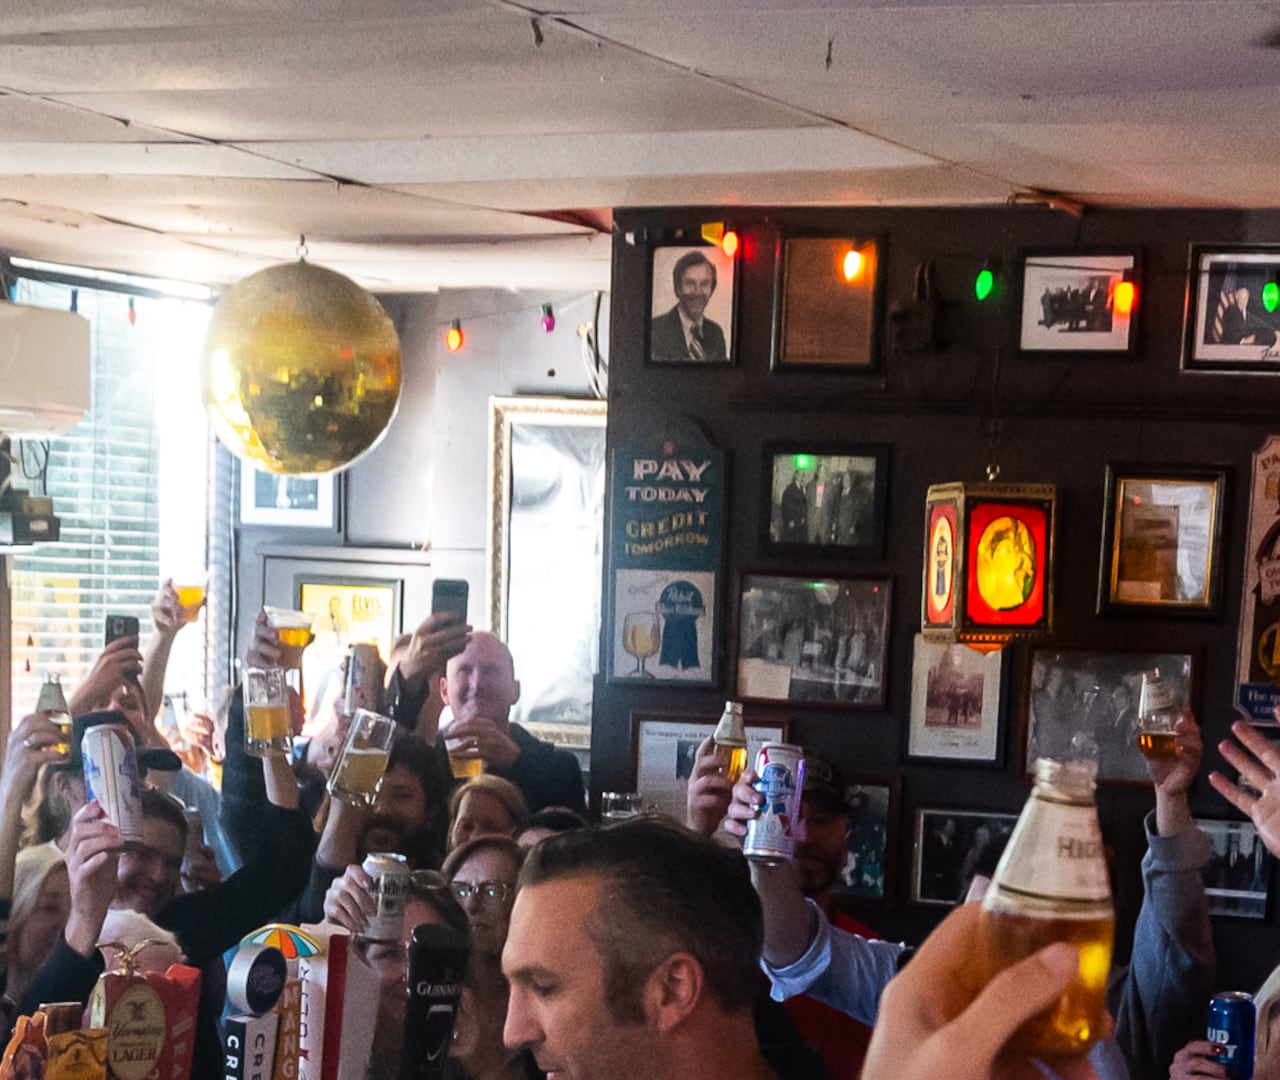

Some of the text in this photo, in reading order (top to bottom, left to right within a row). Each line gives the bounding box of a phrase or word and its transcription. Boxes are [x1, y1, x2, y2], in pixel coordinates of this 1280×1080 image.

[633, 459, 712, 482] PAY
[625, 486, 709, 503] TODAY
[625, 511, 709, 539] CREDIT
[624, 531, 710, 556] TOMORROW
[352, 593, 382, 610] ELVIS
[1247, 690, 1268, 702] The
[1206, 1026, 1230, 1045] UD
[112, 1047, 157, 1062] LAGER
